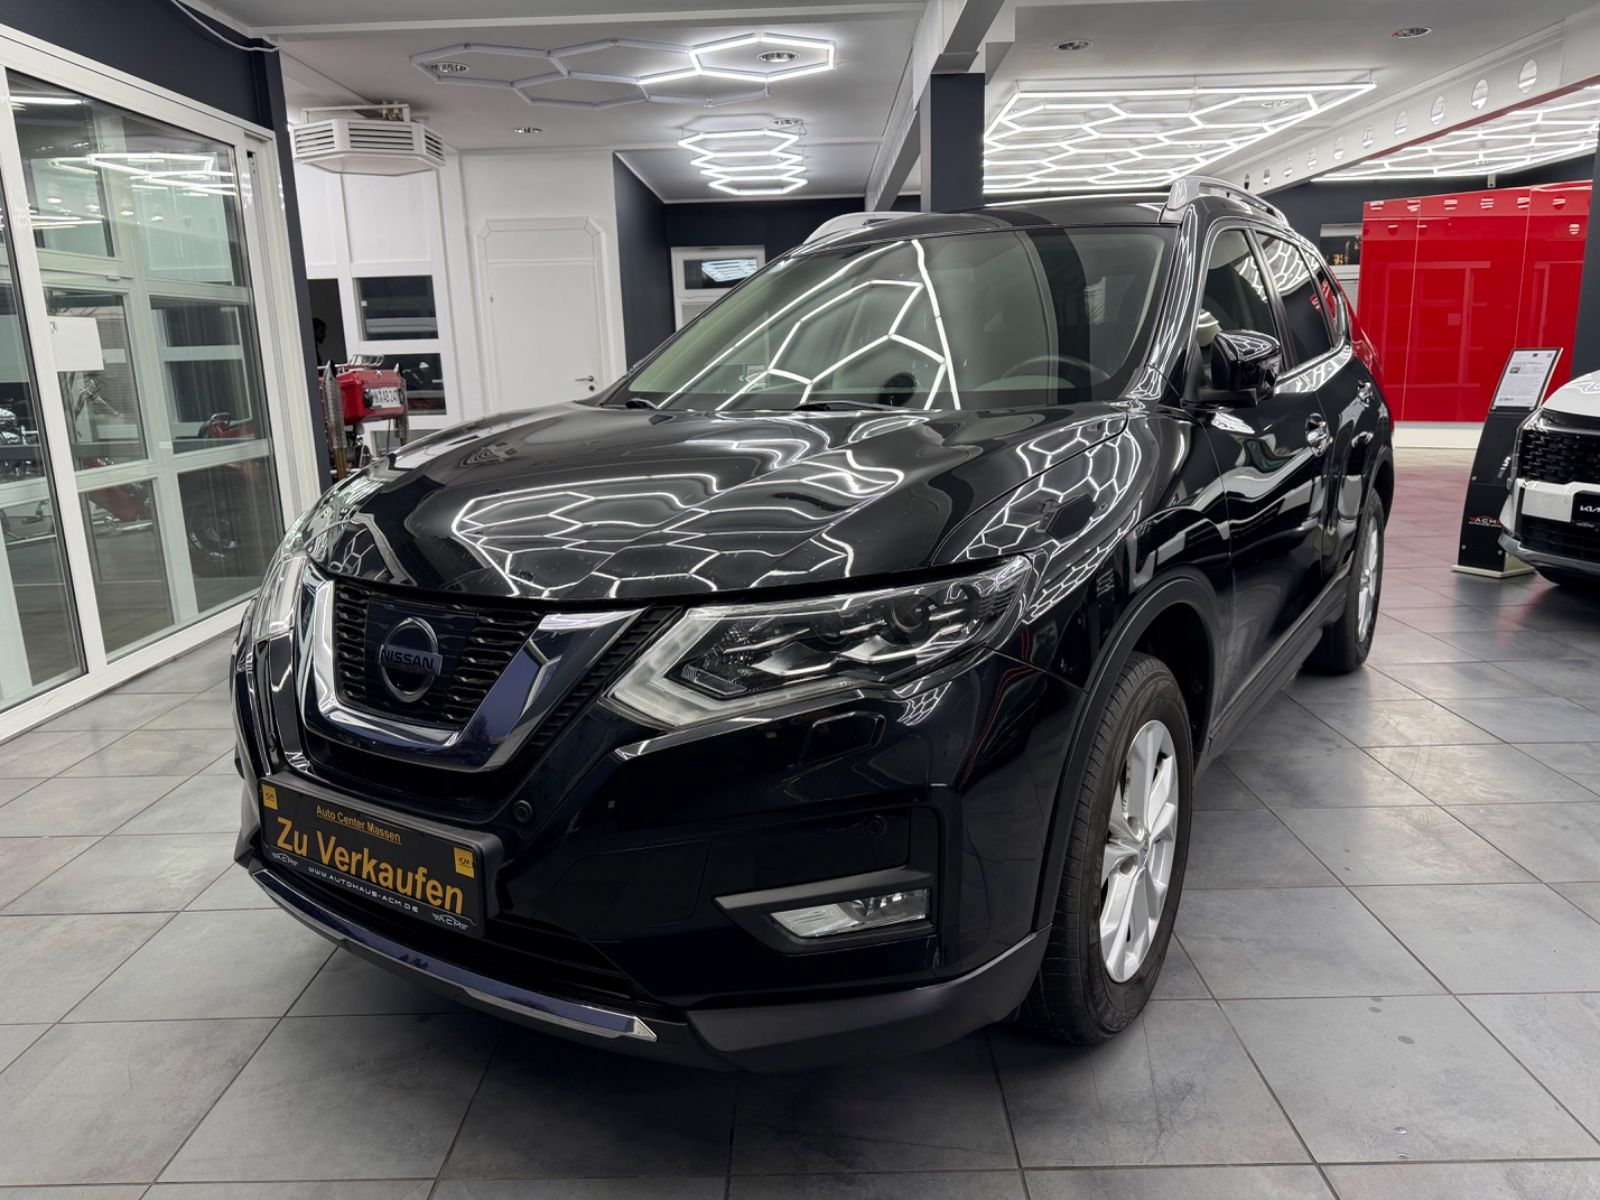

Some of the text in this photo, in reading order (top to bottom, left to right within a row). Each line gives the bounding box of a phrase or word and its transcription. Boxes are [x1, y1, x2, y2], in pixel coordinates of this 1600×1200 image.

[383, 649, 434, 670] NISSAN
[316, 804, 401, 843] Auto Center Massen
[277, 816, 464, 914] Zu Verkaufen
